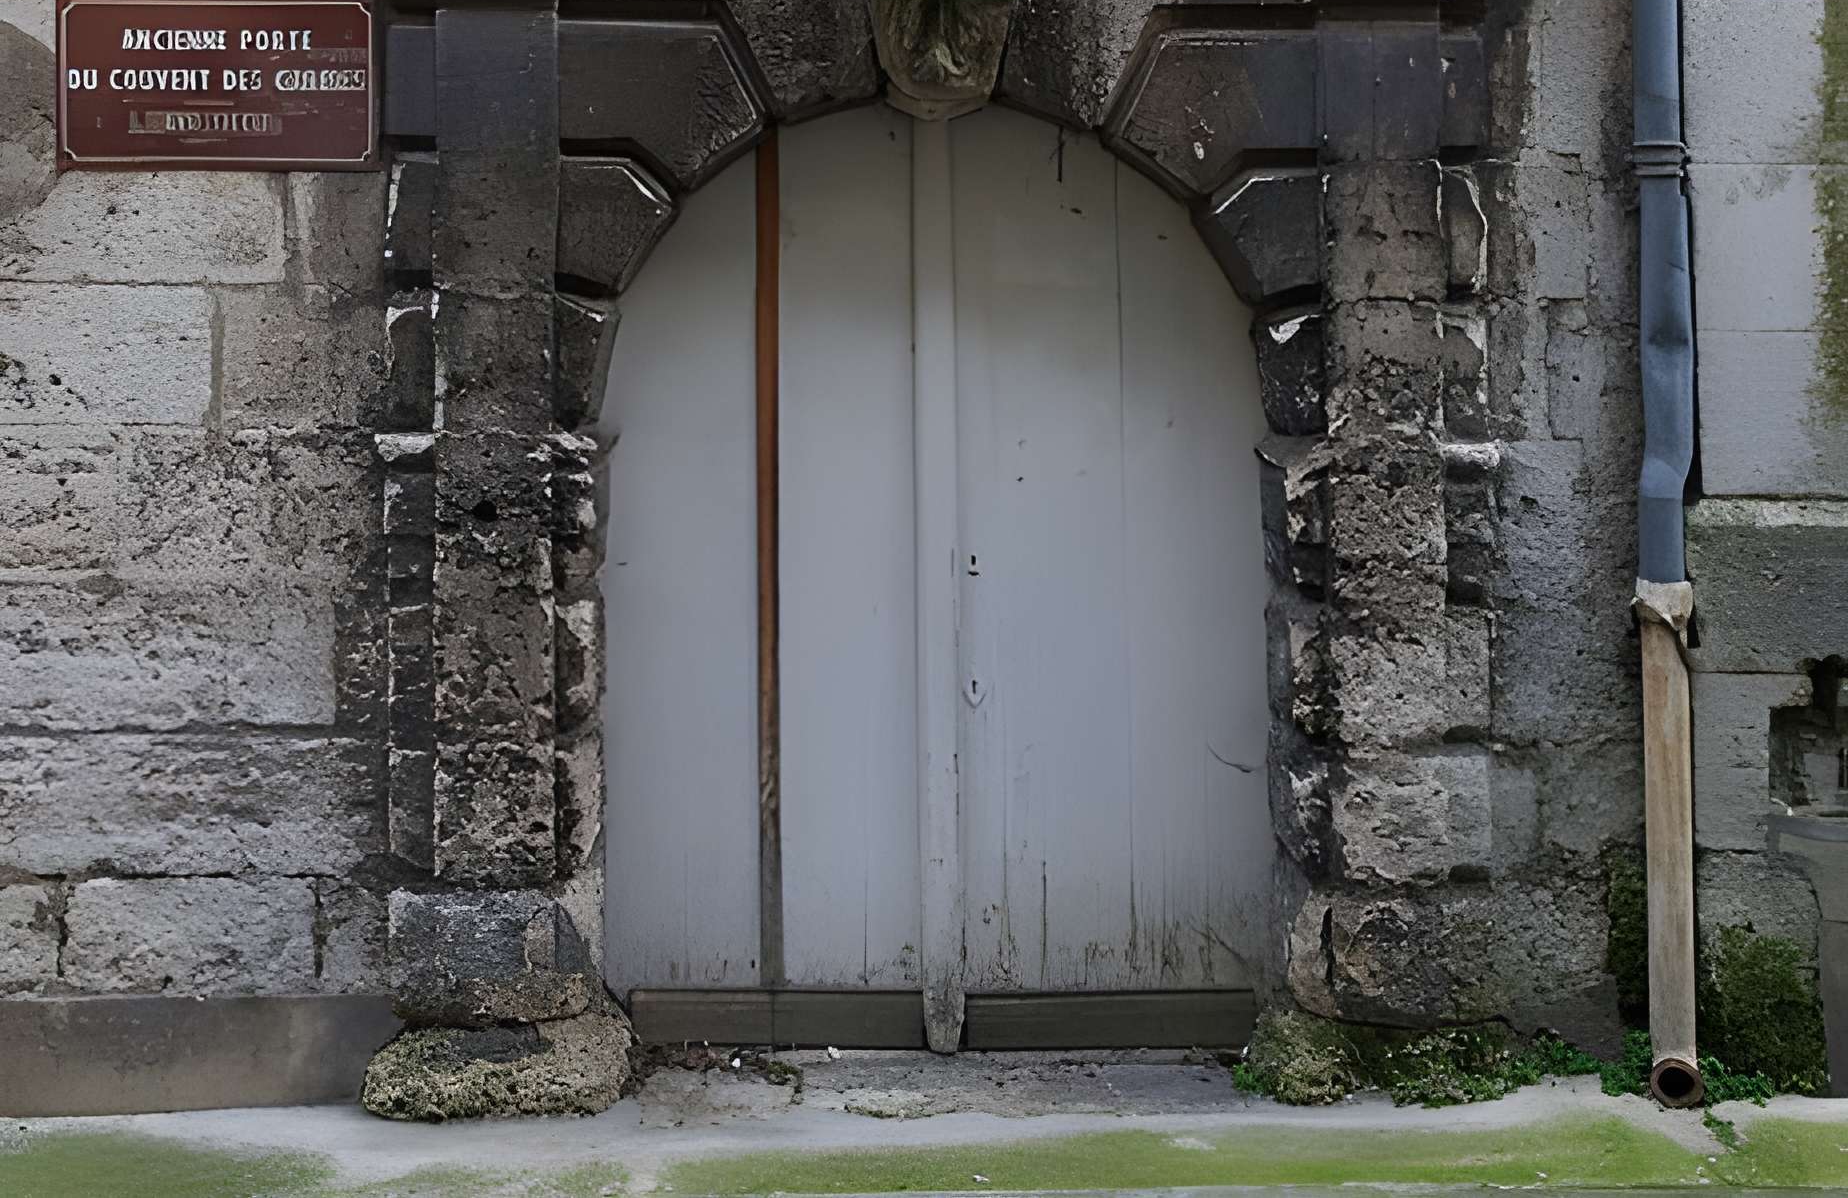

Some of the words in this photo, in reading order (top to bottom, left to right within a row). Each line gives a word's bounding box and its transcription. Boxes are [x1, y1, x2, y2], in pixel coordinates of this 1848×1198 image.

[240, 29, 312, 50] PORTE
[68, 69, 98, 91] DU
[109, 69, 210, 91] COUVENT
[223, 69, 262, 91] DES
